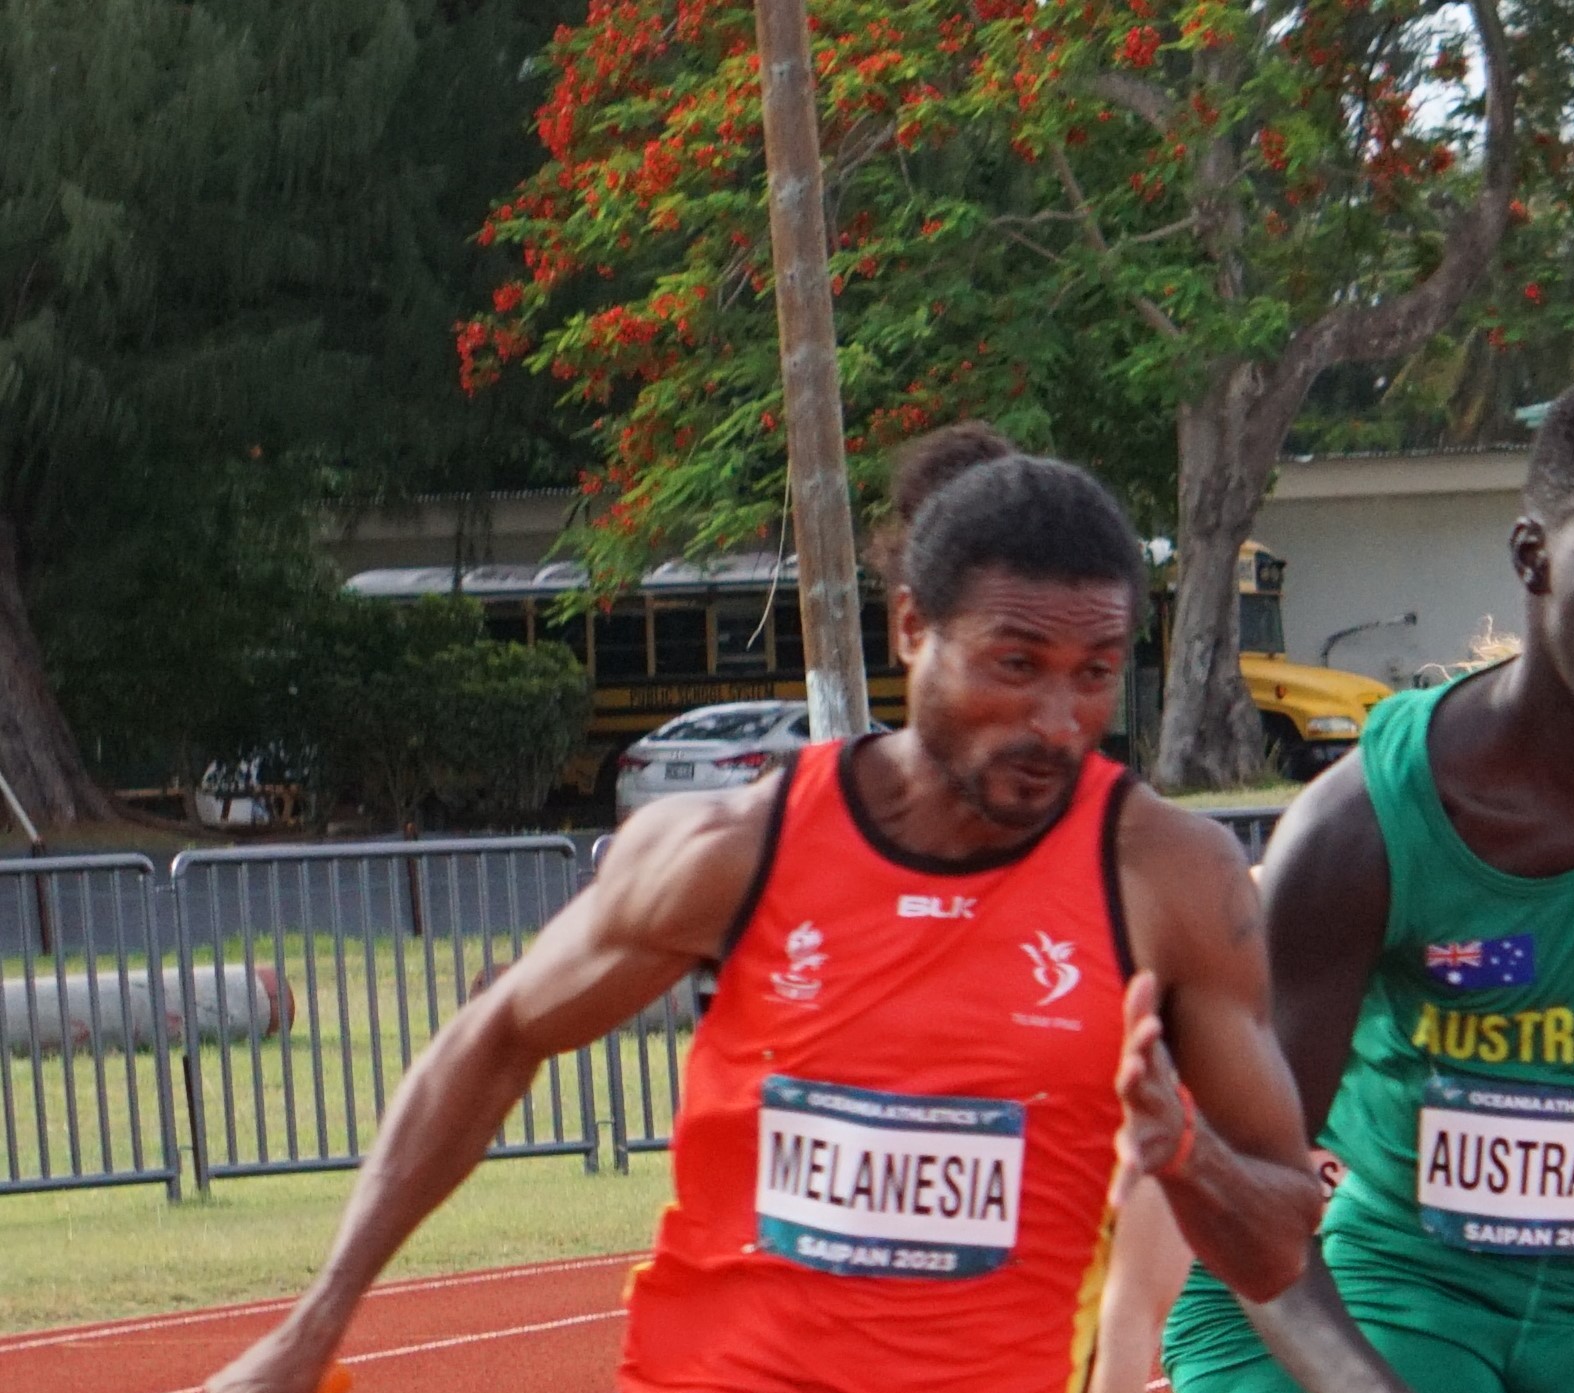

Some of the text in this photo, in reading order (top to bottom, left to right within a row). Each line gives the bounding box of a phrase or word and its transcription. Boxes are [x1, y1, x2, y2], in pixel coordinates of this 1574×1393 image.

[897, 895, 977, 919] BLK
[1468, 1092, 1545, 1110] OCEANIA
[770, 1130, 1008, 1221] MELANESIA
[1463, 1223, 1551, 1246] SAIPAN
[797, 1235, 890, 1267] SAIPAN
